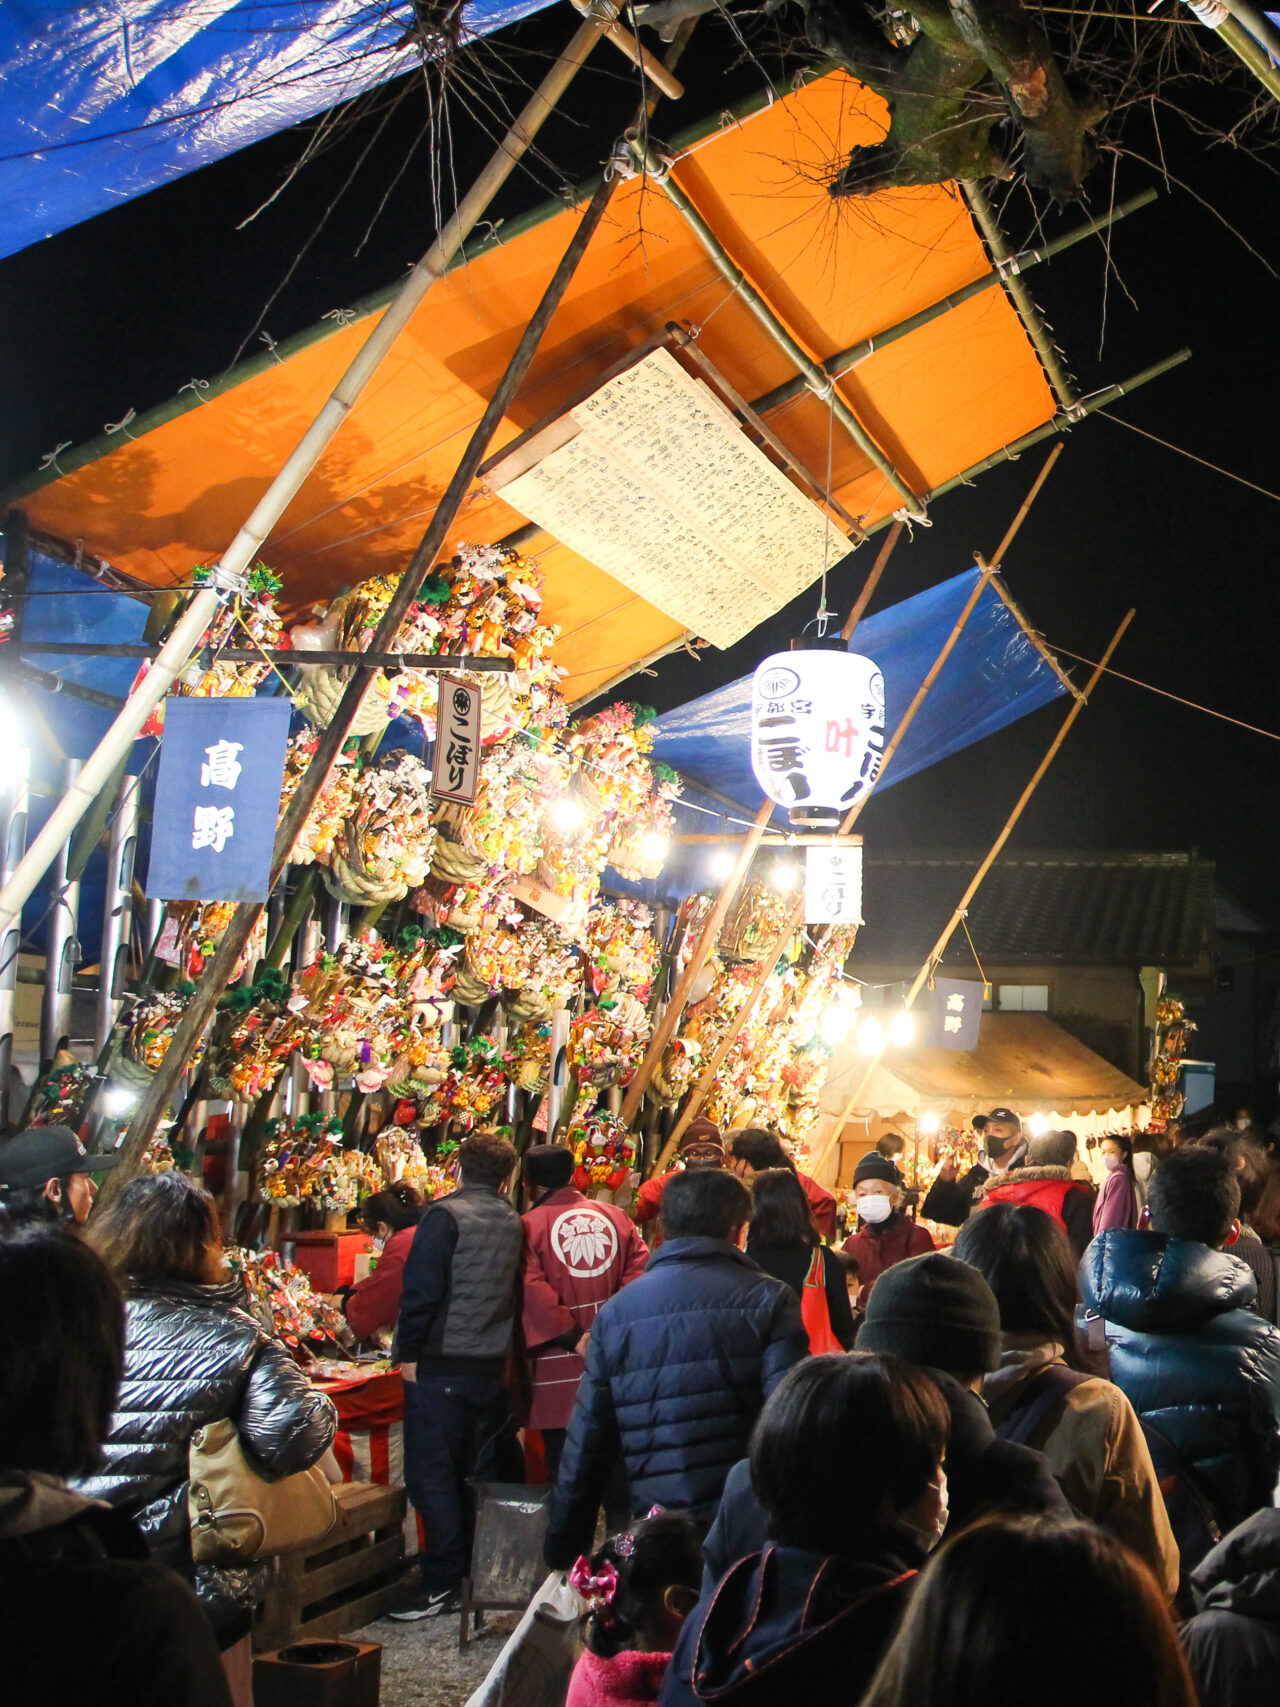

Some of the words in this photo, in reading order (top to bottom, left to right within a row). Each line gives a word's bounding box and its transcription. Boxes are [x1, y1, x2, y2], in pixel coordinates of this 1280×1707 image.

[192, 739, 244, 853] 高野
[446, 714, 473, 792] こぼり
